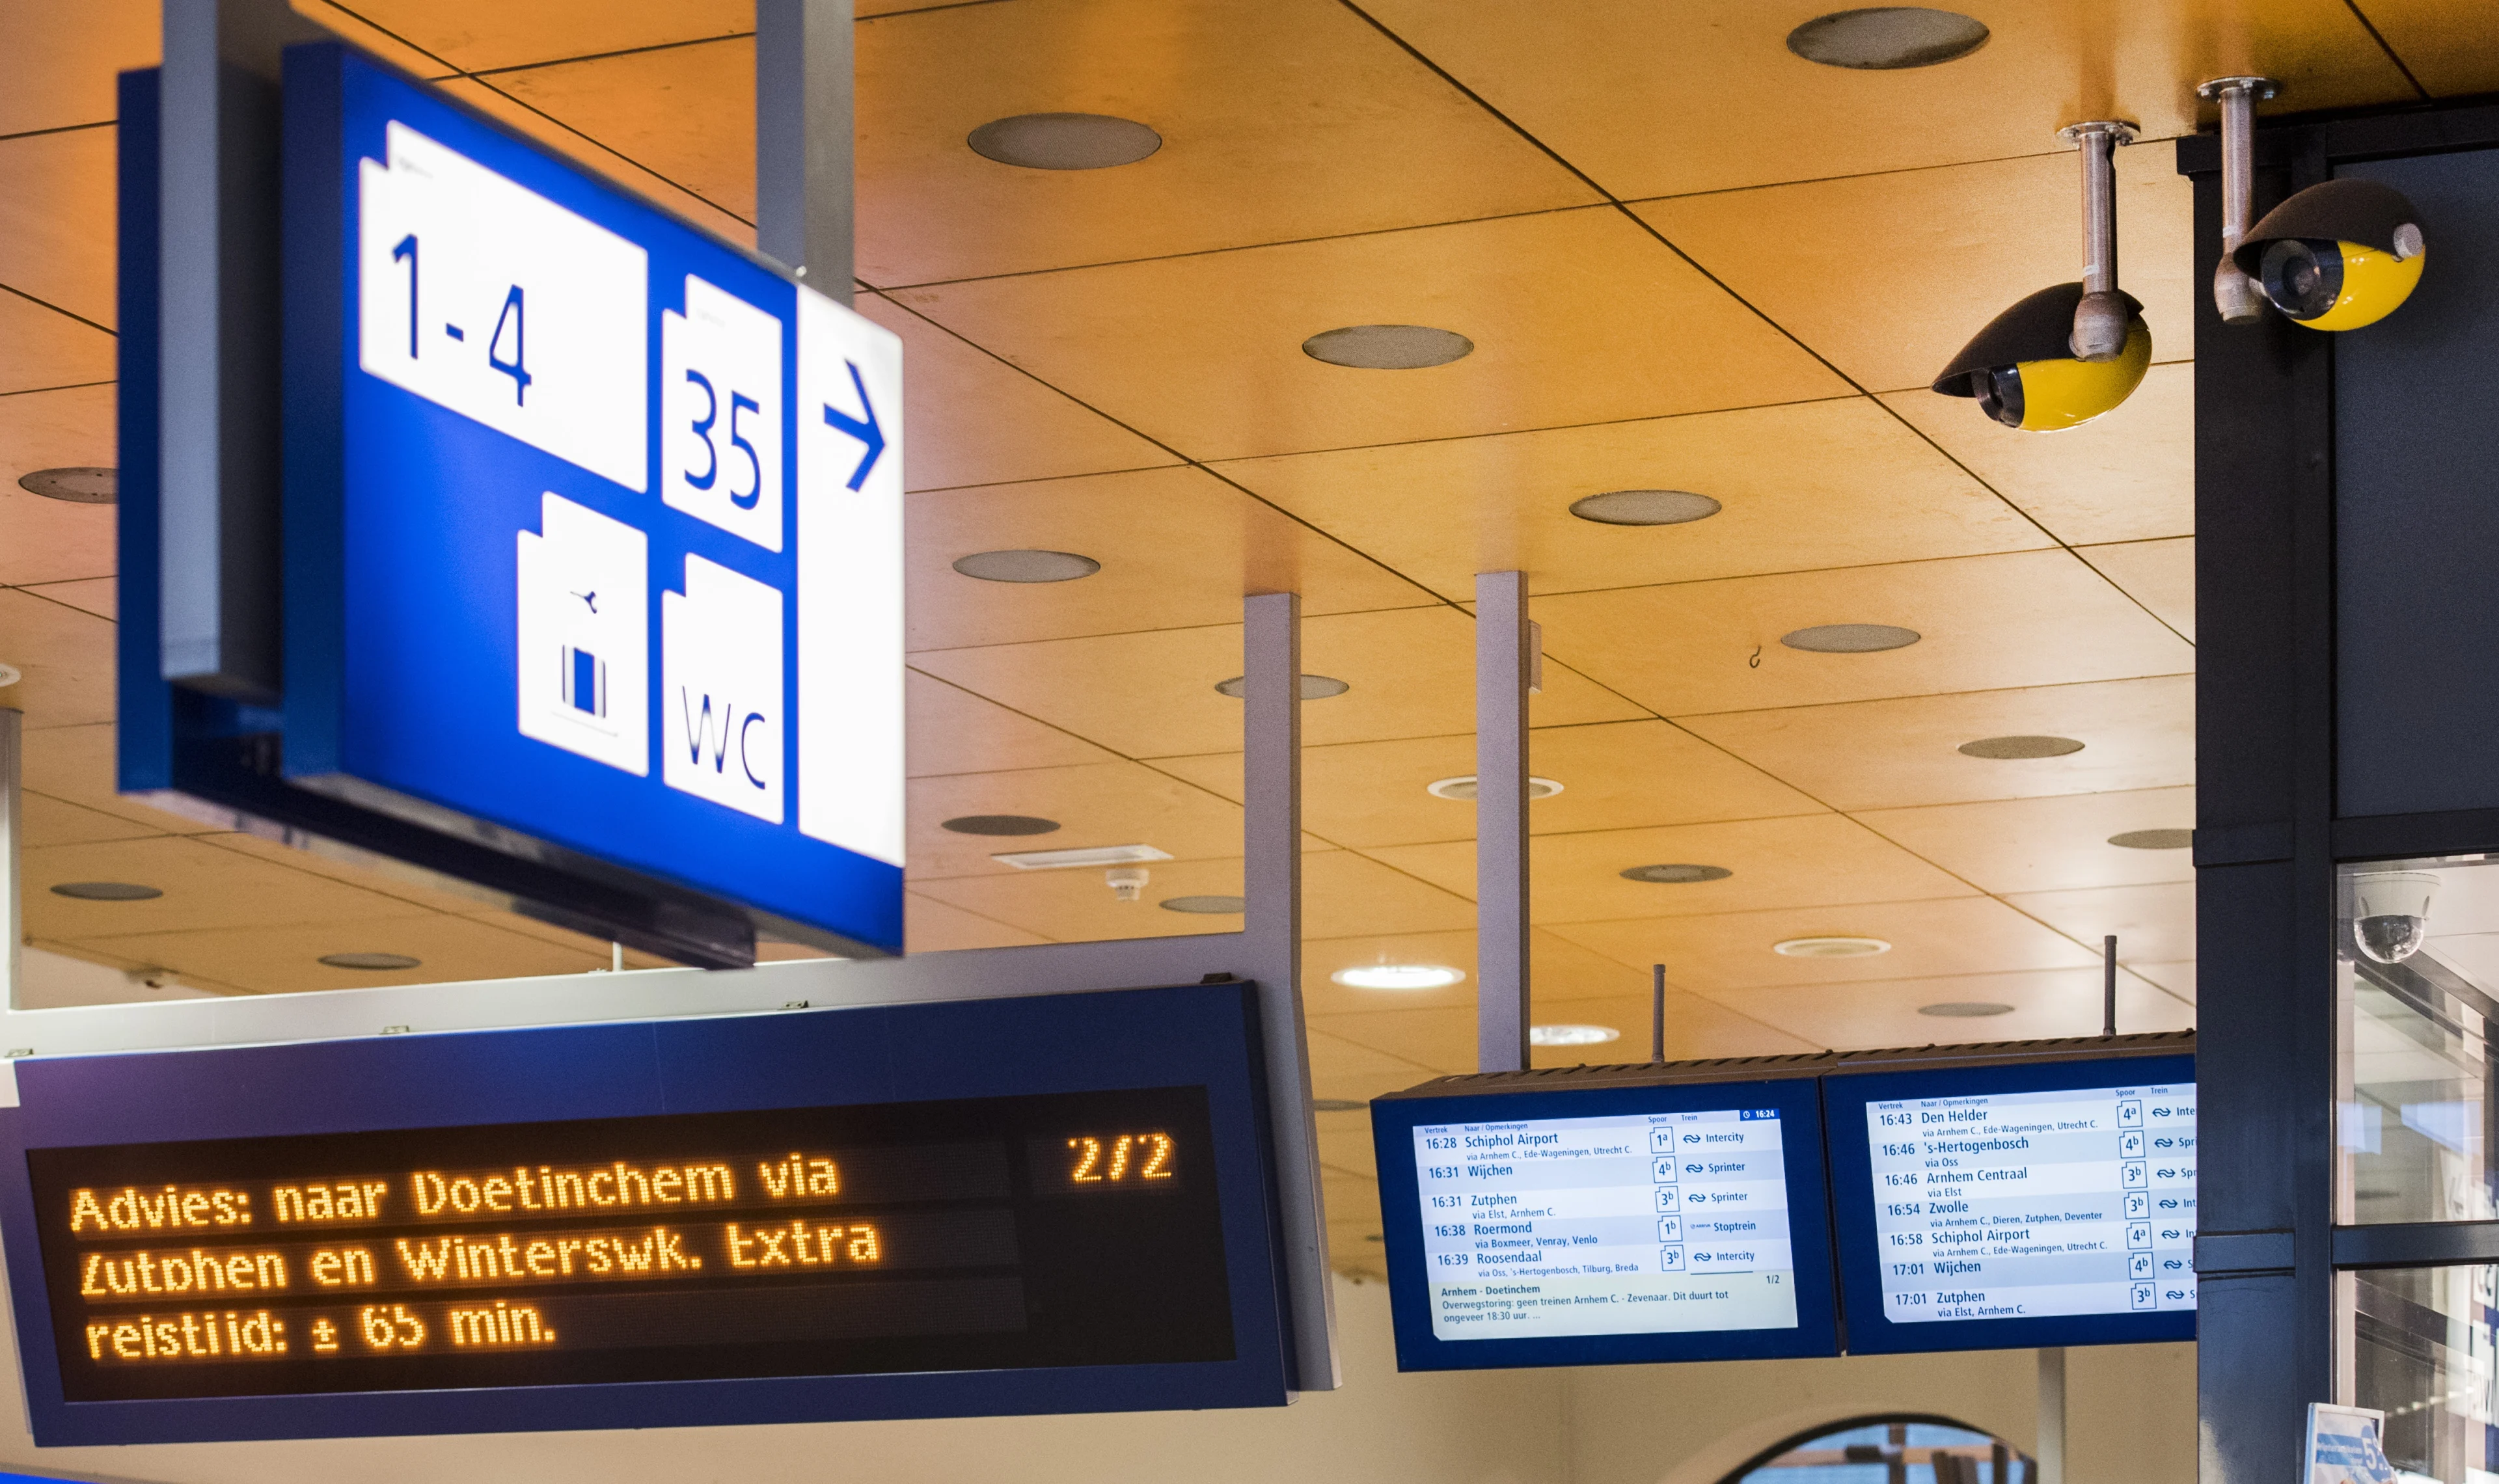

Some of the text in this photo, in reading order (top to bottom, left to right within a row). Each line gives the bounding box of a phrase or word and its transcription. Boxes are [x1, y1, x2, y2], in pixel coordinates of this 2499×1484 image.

[684, 368, 761, 510] 35
[682, 684, 766, 790] WC
[1943, 1098, 1988, 1107] Opmerkingen
[1486, 1122, 1528, 1131] Opmerkingen
[1648, 1115, 1667, 1124] Spoor
[1880, 1113, 1912, 1126] 16:43
[1921, 1112, 1945, 1124] Den
[1948, 1109, 1988, 1122] Helder
[1937, 1127, 1968, 1136] Arnhem
[1971, 1127, 1981, 1135] C.,
[1984, 1124, 2055, 1135] Ede-Wageningen,
[2057, 1120, 2088, 1130] Utrecht
[2090, 1120, 2098, 1129] C.
[1426, 1137, 1457, 1150] 16:28
[1465, 1134, 1513, 1149] Schiphol
[1518, 1133, 1558, 1146] Airport
[1706, 1133, 1744, 1144] Intercity
[1883, 1143, 1915, 1156] 16:46
[1924, 1137, 2028, 1155] 's-Hertogenbosch
[1067, 1131, 1173, 1183] 2/2
[1480, 1151, 1509, 1160] Arnhem
[1512, 1151, 1522, 1159] C.,
[1524, 1148, 1591, 1159] Ede-Wageningen,
[1594, 1146, 1622, 1155] Utrecht
[1925, 1157, 1958, 1168] via Oss
[1429, 1167, 1458, 1179] 16:31
[1468, 1165, 1512, 1180] Wijchen
[1708, 1162, 1745, 1174] Sprinter
[1885, 1173, 1918, 1186] 16:46
[1927, 1170, 1973, 1183] Arnhem
[1978, 1167, 2027, 1180] Centraal
[70, 1153, 839, 1232] Advies: naar Doetinchem via
[1432, 1196, 1461, 1207] 16:31
[1471, 1193, 1517, 1208] Zutphen
[1711, 1192, 1748, 1204] Sprinter
[1928, 1187, 1962, 1198] via Elst
[1488, 1210, 1507, 1219] Elst,
[1510, 1208, 1544, 1217] Arnhem
[1548, 1207, 1556, 1216] C.
[1888, 1204, 1920, 1216] 16:54
[1929, 1200, 1969, 1214] Zwolle
[1945, 1217, 1978, 1226] Arnhem
[1980, 1217, 1990, 1226] C.,
[1993, 1216, 2023, 1225] Dieren,
[2025, 1213, 2062, 1223] Zutphen,
[2064, 1212, 2103, 1221] Deventer
[1435, 1225, 1466, 1237] 16:38
[1474, 1221, 1532, 1235] Roermond
[1714, 1221, 1756, 1233] Stoptrein
[1492, 1238, 1533, 1248] Boxmeer,
[1536, 1237, 1570, 1247] Venray,
[1572, 1235, 1598, 1245] Venlo
[1890, 1234, 1922, 1246] 16:58
[1932, 1230, 1982, 1245] Schiphol
[1987, 1229, 2030, 1243] Airport
[311, 1248, 376, 1286] en
[396, 1224, 703, 1280] Winterswk.
[1947, 1247, 1978, 1256] Arnhem
[1981, 1247, 1991, 1256] C.,
[1994, 1243, 2064, 1255] Ede-Wageningen,
[2067, 1242, 2097, 1251] Utrecht
[2099, 1241, 2107, 1250] C.
[1438, 1254, 1468, 1265] 16:39
[1477, 1250, 1542, 1264] Roosendaal
[1717, 1250, 1755, 1261] Intercity
[1510, 1265, 1580, 1276] 's-Hertogenbosch,
[1582, 1265, 1613, 1274] Tilburg,
[1615, 1263, 1639, 1272] Breda
[1893, 1263, 1924, 1275] 17:01
[1933, 1261, 1981, 1276] Wijchen
[1766, 1275, 1780, 1284] 1/2
[1441, 1288, 1477, 1297] Arnhem
[1485, 1284, 1540, 1295] Doetinchem
[1896, 1293, 1926, 1305] 17:01
[1937, 1290, 1985, 1306] Zutphen
[1442, 1299, 1514, 1310] Overwegstoring:
[1517, 1299, 1538, 1308] geen
[1540, 1297, 1572, 1306] treinen
[1574, 1295, 1607, 1304] Arnhem
[1611, 1294, 1619, 1302] C.
[1628, 1293, 1671, 1302] Zevenaar.
[1673, 1291, 1686, 1301] Dit
[1689, 1291, 1713, 1300] duurt
[1443, 1314, 1484, 1324] ongeveer
[1487, 1312, 1510, 1321] 18:30
[1938, 1304, 2025, 1317] via Elst, Arnhem C.
[362, 1304, 425, 1347] 65
[451, 1301, 555, 1345] min.
